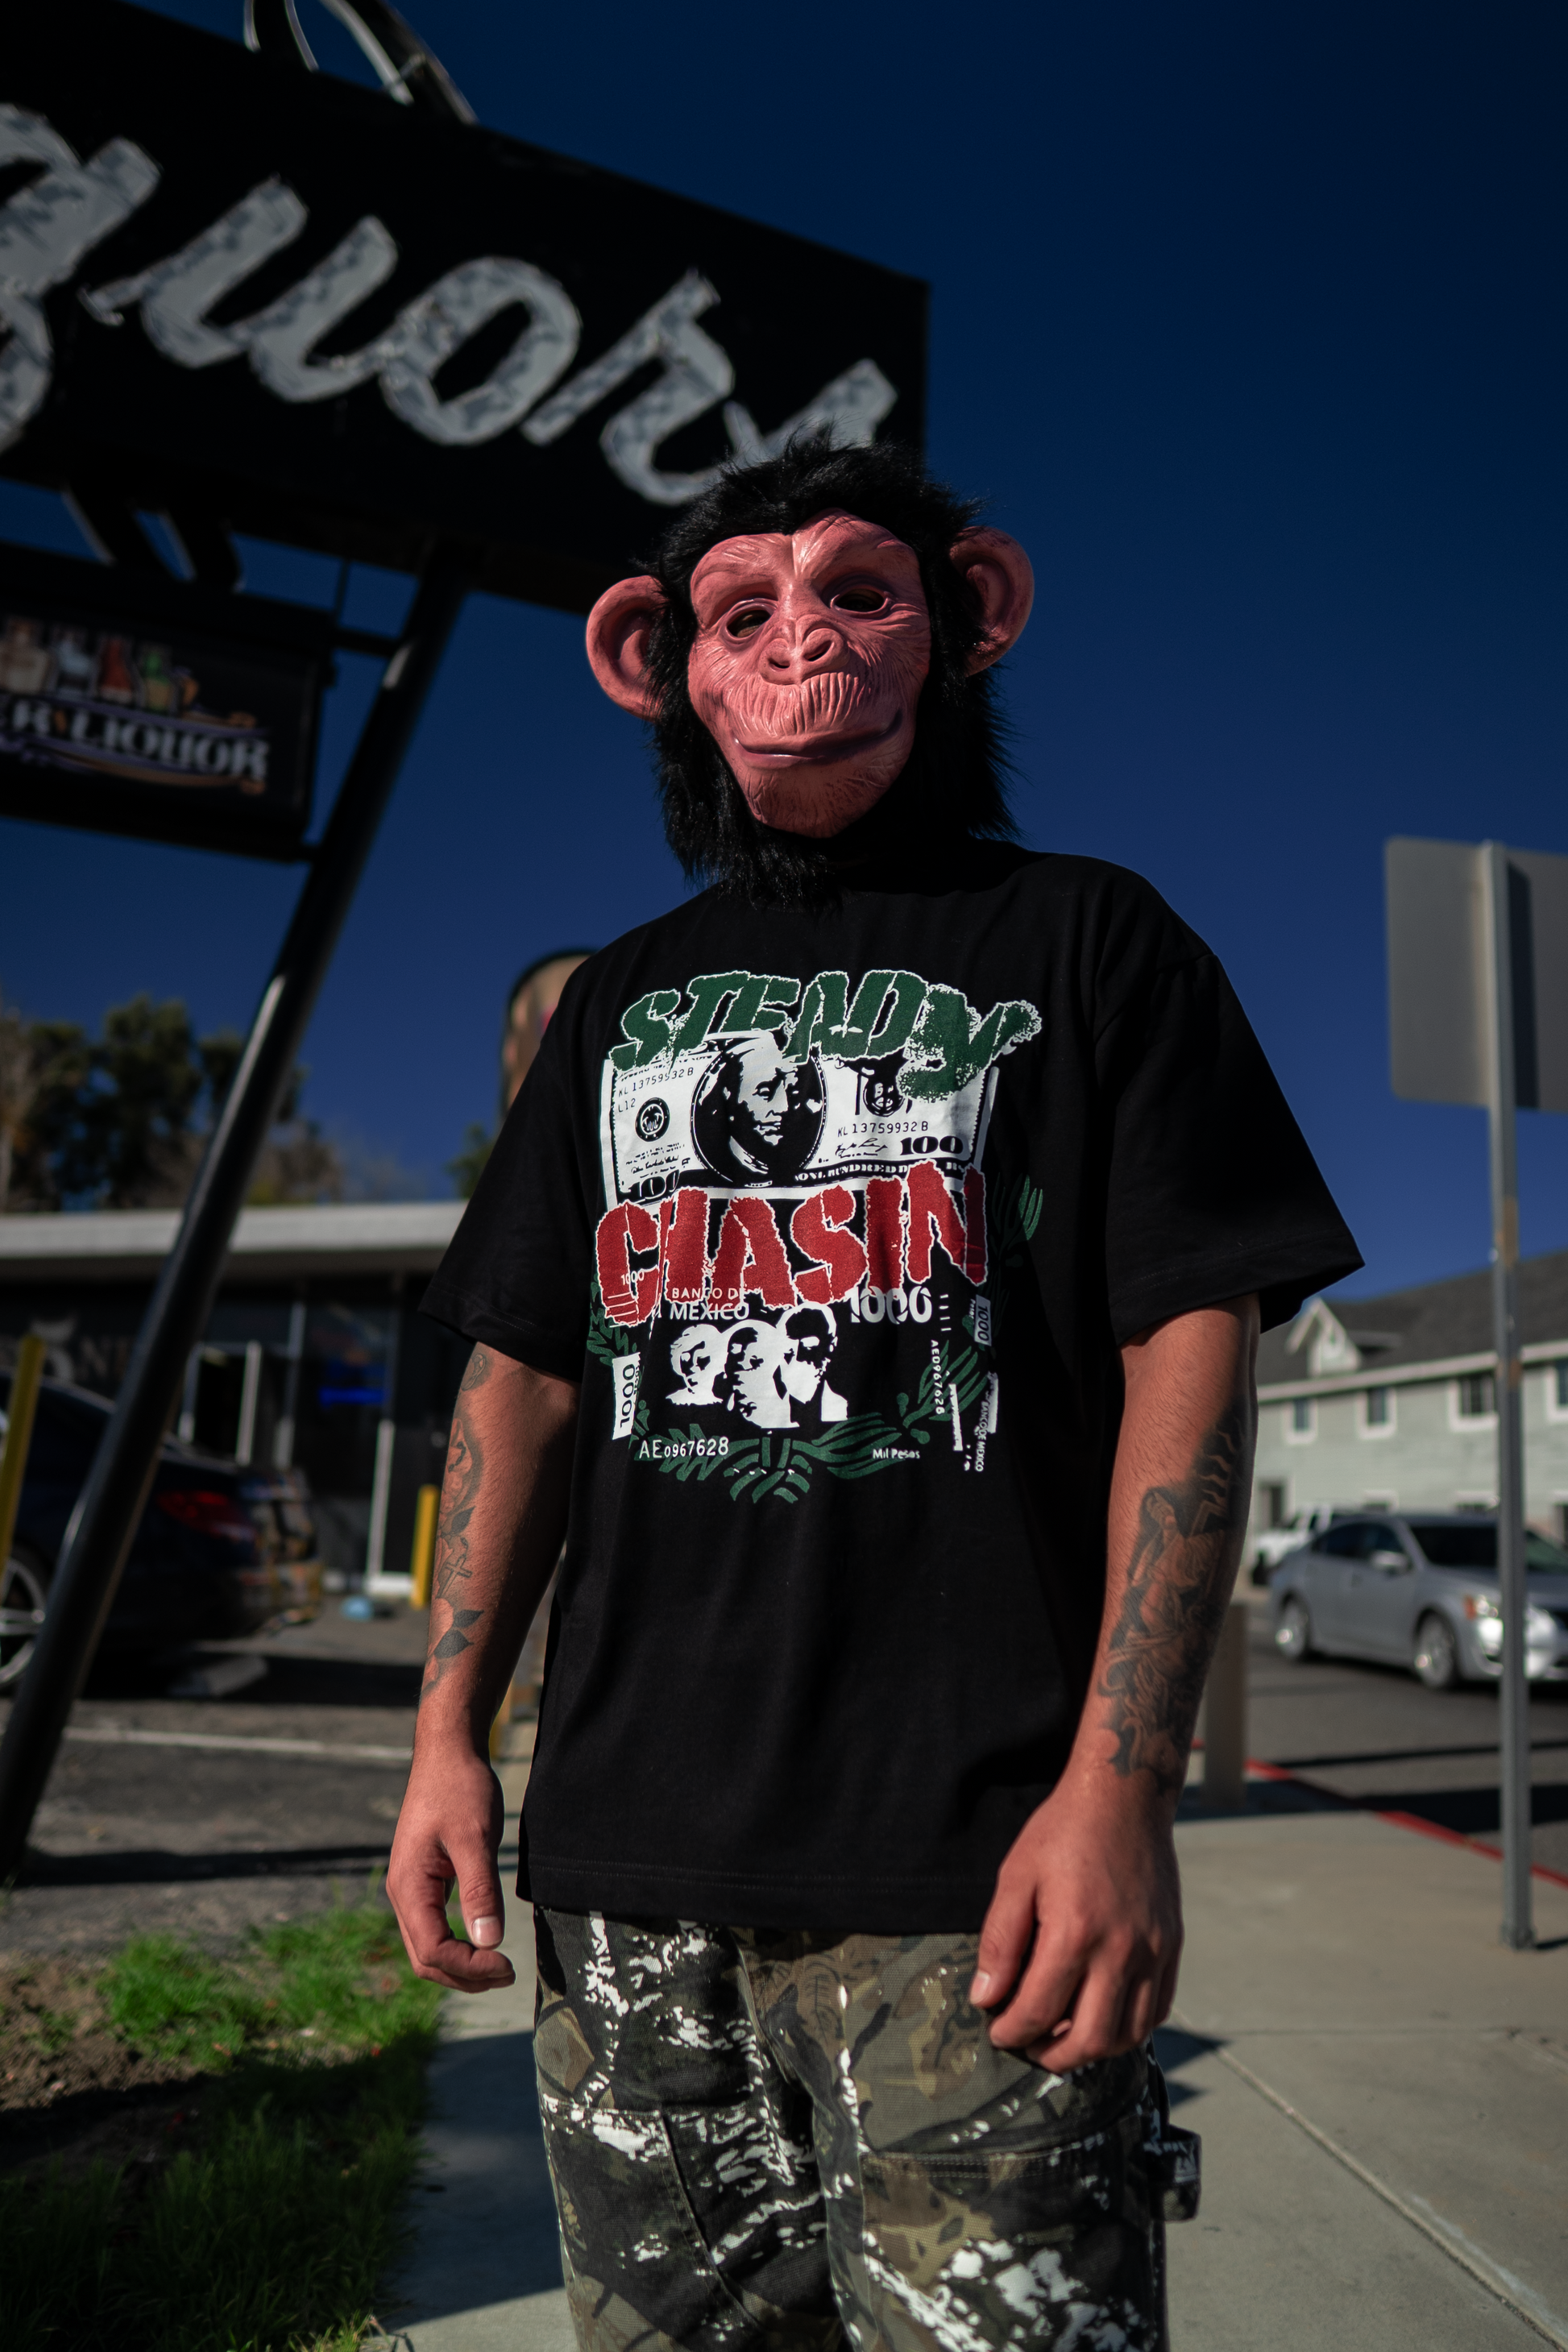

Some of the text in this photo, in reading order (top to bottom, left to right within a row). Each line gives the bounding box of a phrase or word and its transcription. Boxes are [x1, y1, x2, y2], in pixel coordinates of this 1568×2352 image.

[852, 1120, 918, 1135] 13759932
[921, 1120, 929, 1131] B
[899, 1135, 964, 1156] 100
[670, 1302, 750, 1321] MEXICO
[845, 1285, 932, 1325] 1000
[977, 1305, 990, 1342] 1000
[872, 1449, 890, 1460] Mil
